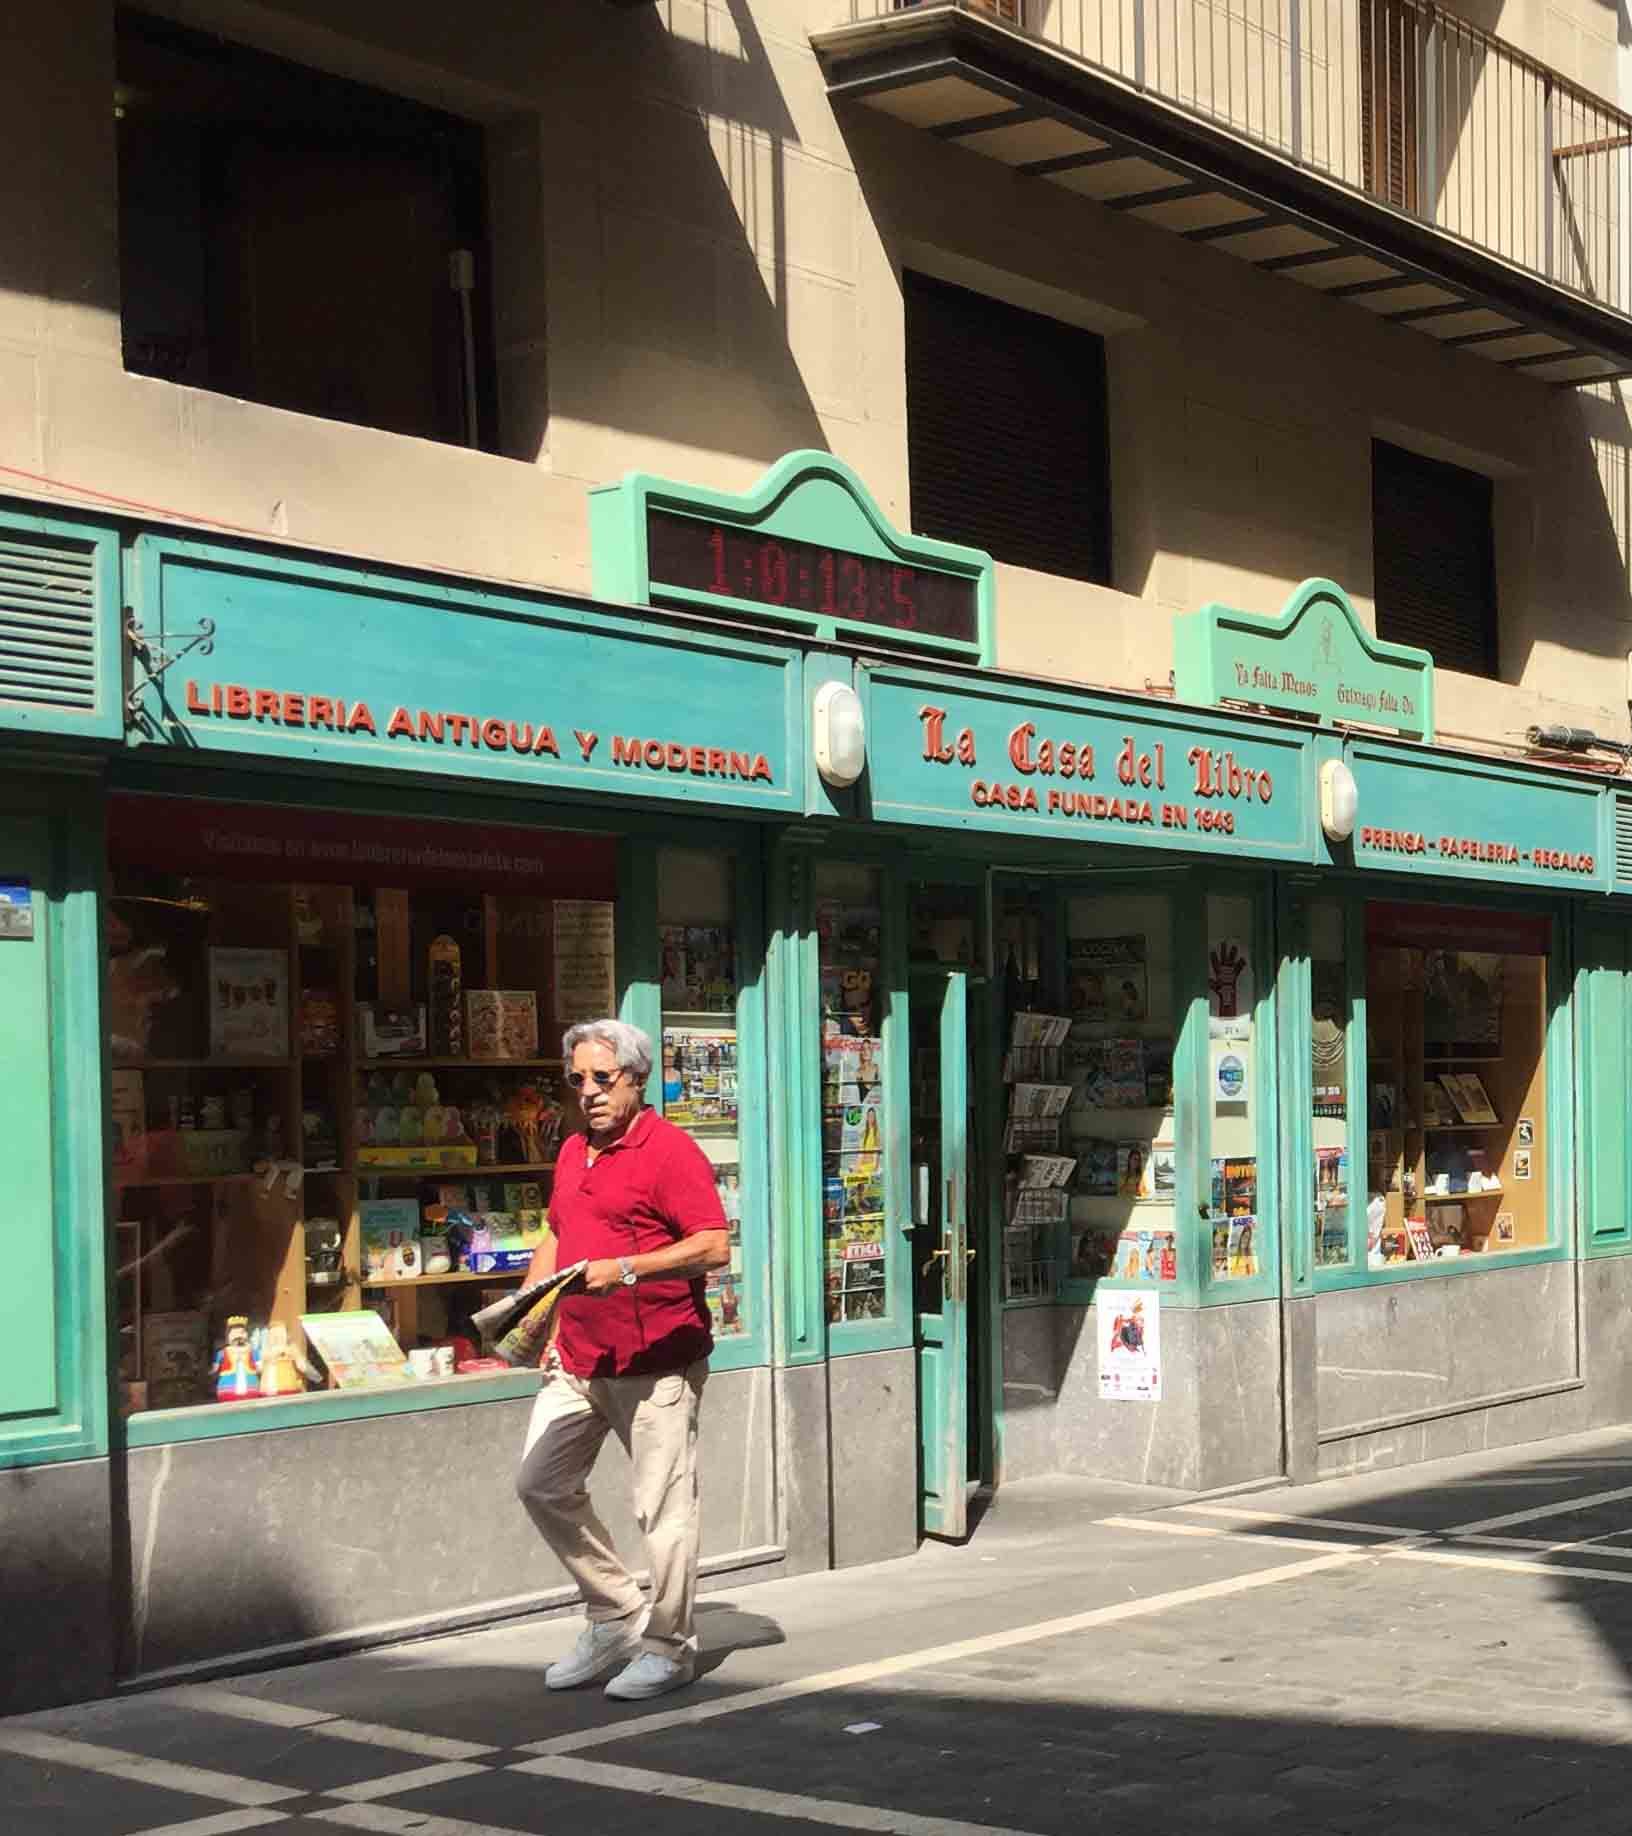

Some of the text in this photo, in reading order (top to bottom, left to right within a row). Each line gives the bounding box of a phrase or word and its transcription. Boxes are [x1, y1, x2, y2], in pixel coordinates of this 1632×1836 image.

[187, 681, 774, 784] LIBRERIA ANTIGUA Y MODERNA
[919, 704, 1273, 805] La Casa del Libro
[971, 780, 1038, 811] CASA
[1047, 789, 1154, 828] FUNDADA
[1161, 804, 1188, 829] EN
[1360, 827, 1426, 855] PRENSA
[1440, 836, 1518, 866] PAPELERIA
[1533, 848, 1594, 874] REGALOS
